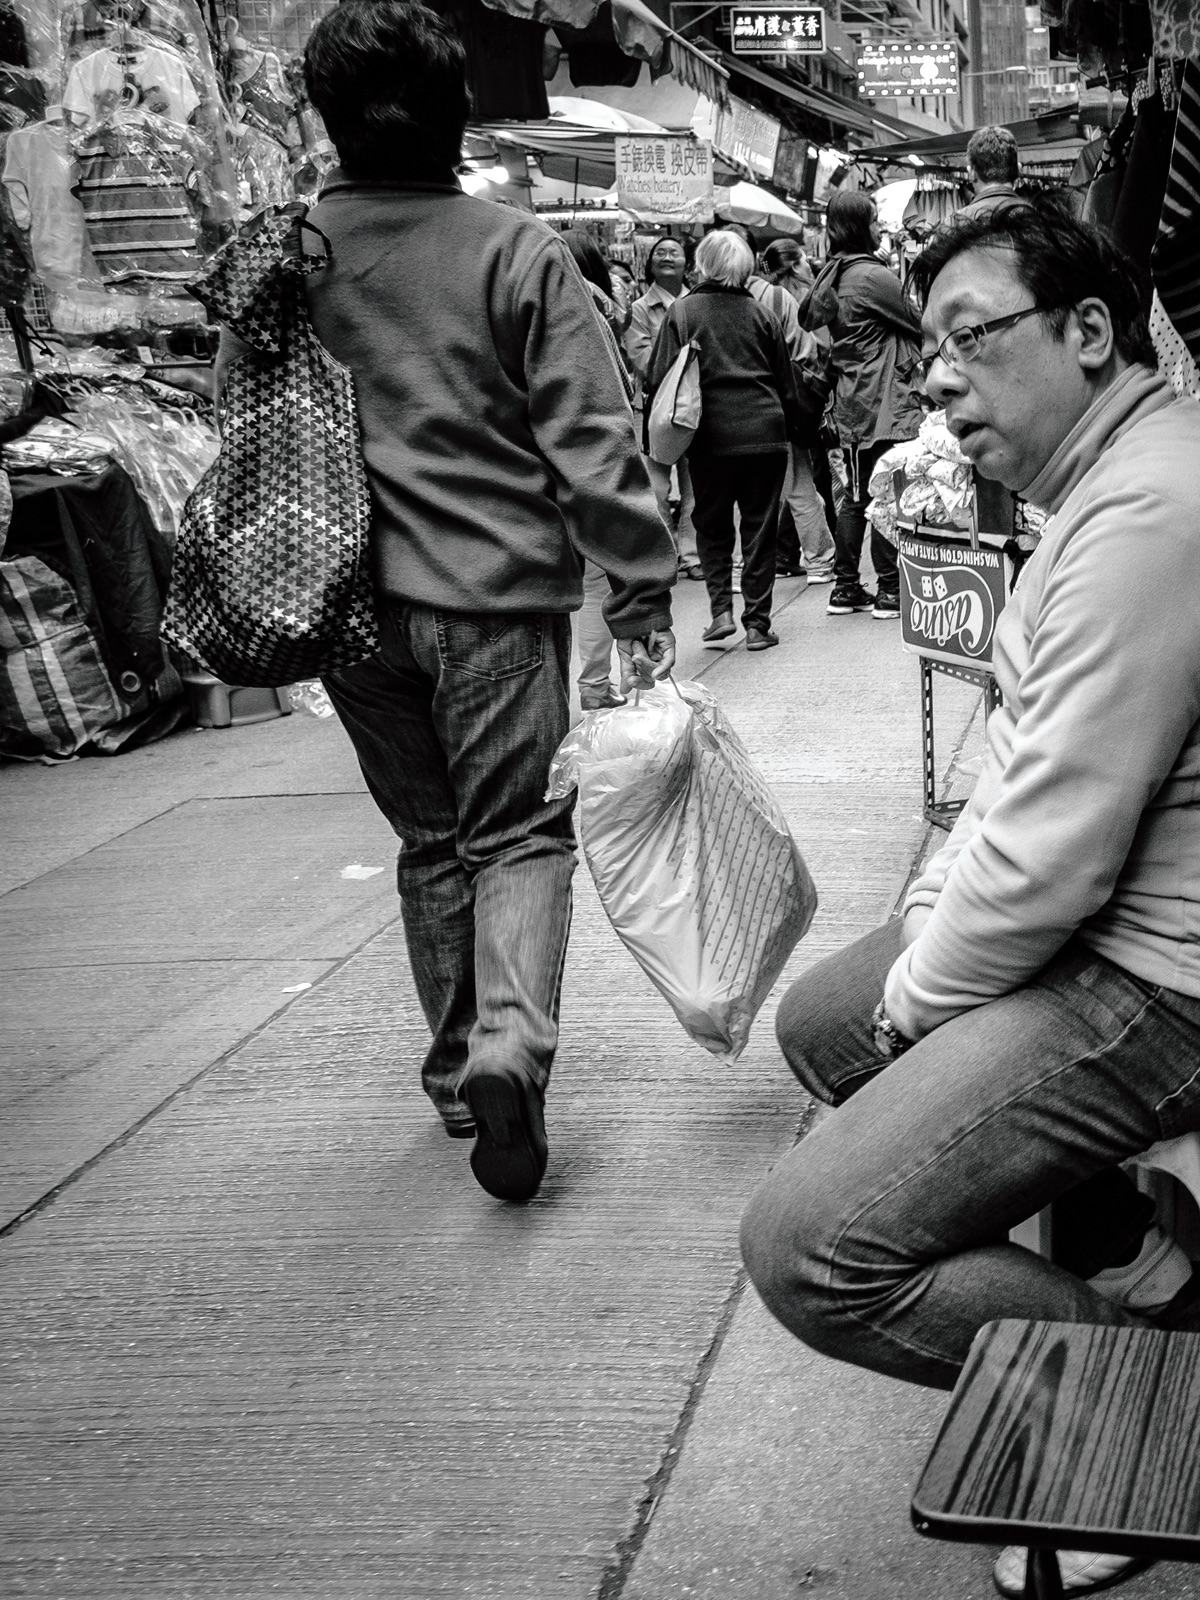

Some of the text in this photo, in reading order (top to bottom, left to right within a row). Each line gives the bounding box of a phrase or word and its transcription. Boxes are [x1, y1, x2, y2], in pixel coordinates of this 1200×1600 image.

[671, 142, 709, 176] 換皮帶
[919, 545, 939, 562] STATE
[940, 549, 1000, 568] WASHINGTON
[906, 570, 995, 656] Casino
